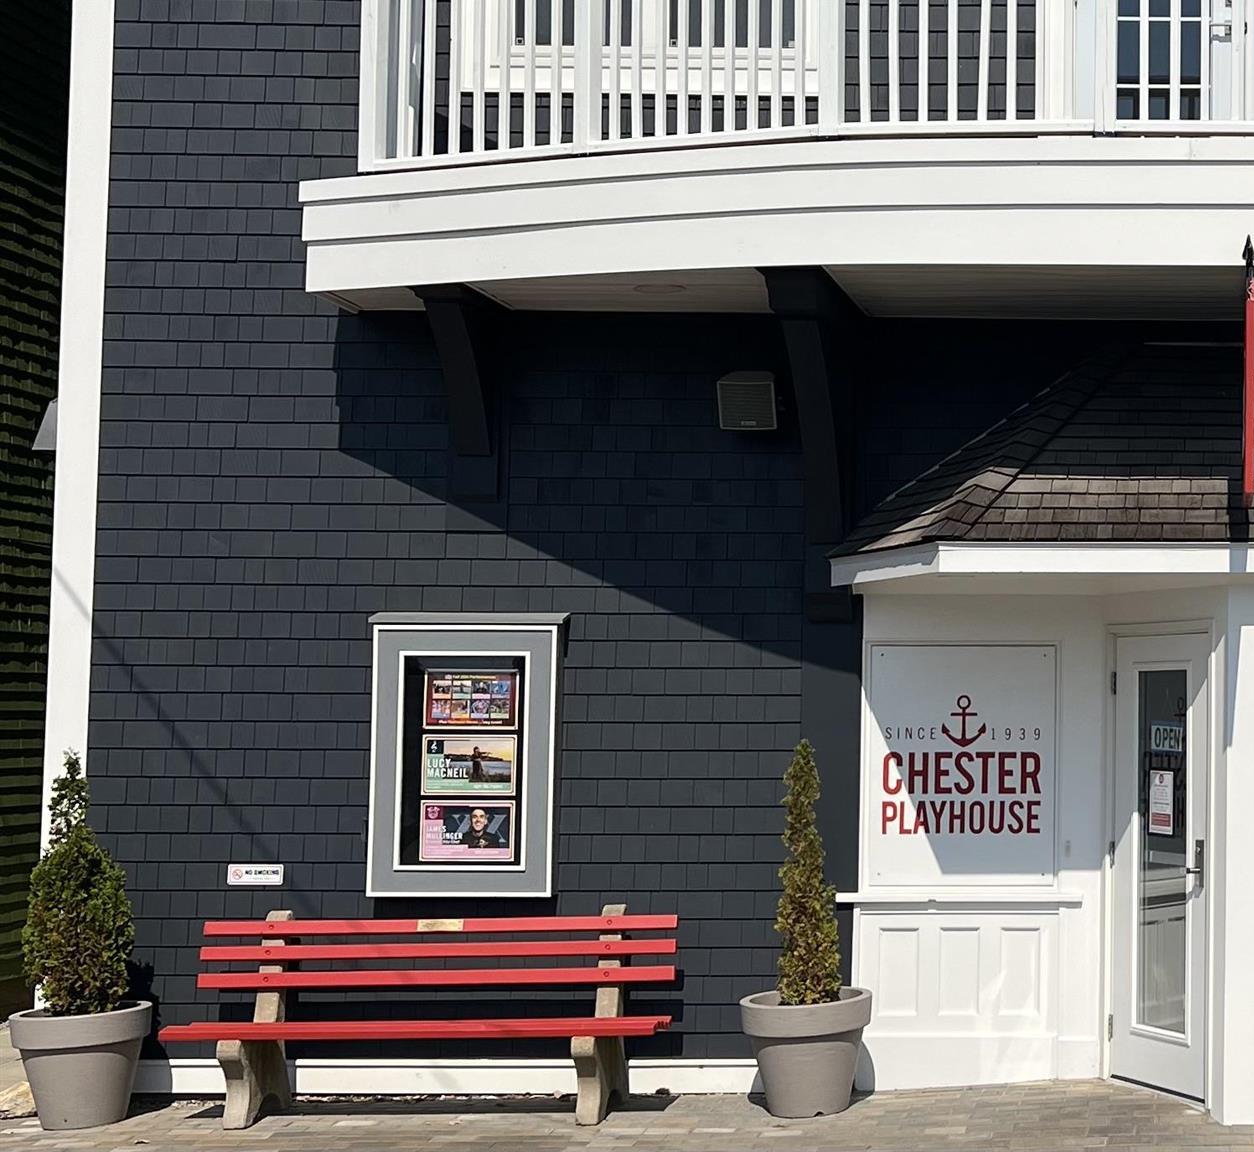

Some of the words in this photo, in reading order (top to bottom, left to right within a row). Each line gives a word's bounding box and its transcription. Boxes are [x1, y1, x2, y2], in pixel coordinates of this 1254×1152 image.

[885, 726, 937, 741] SINCE
[991, 727, 1041, 741] 1939
[1155, 727, 1181, 749] OPEN
[427, 758, 451, 768] LUCY
[427, 768, 468, 778] MACNEIL
[883, 751, 1042, 795] CHESTER
[882, 800, 1042, 835] PLAYHOUSE
